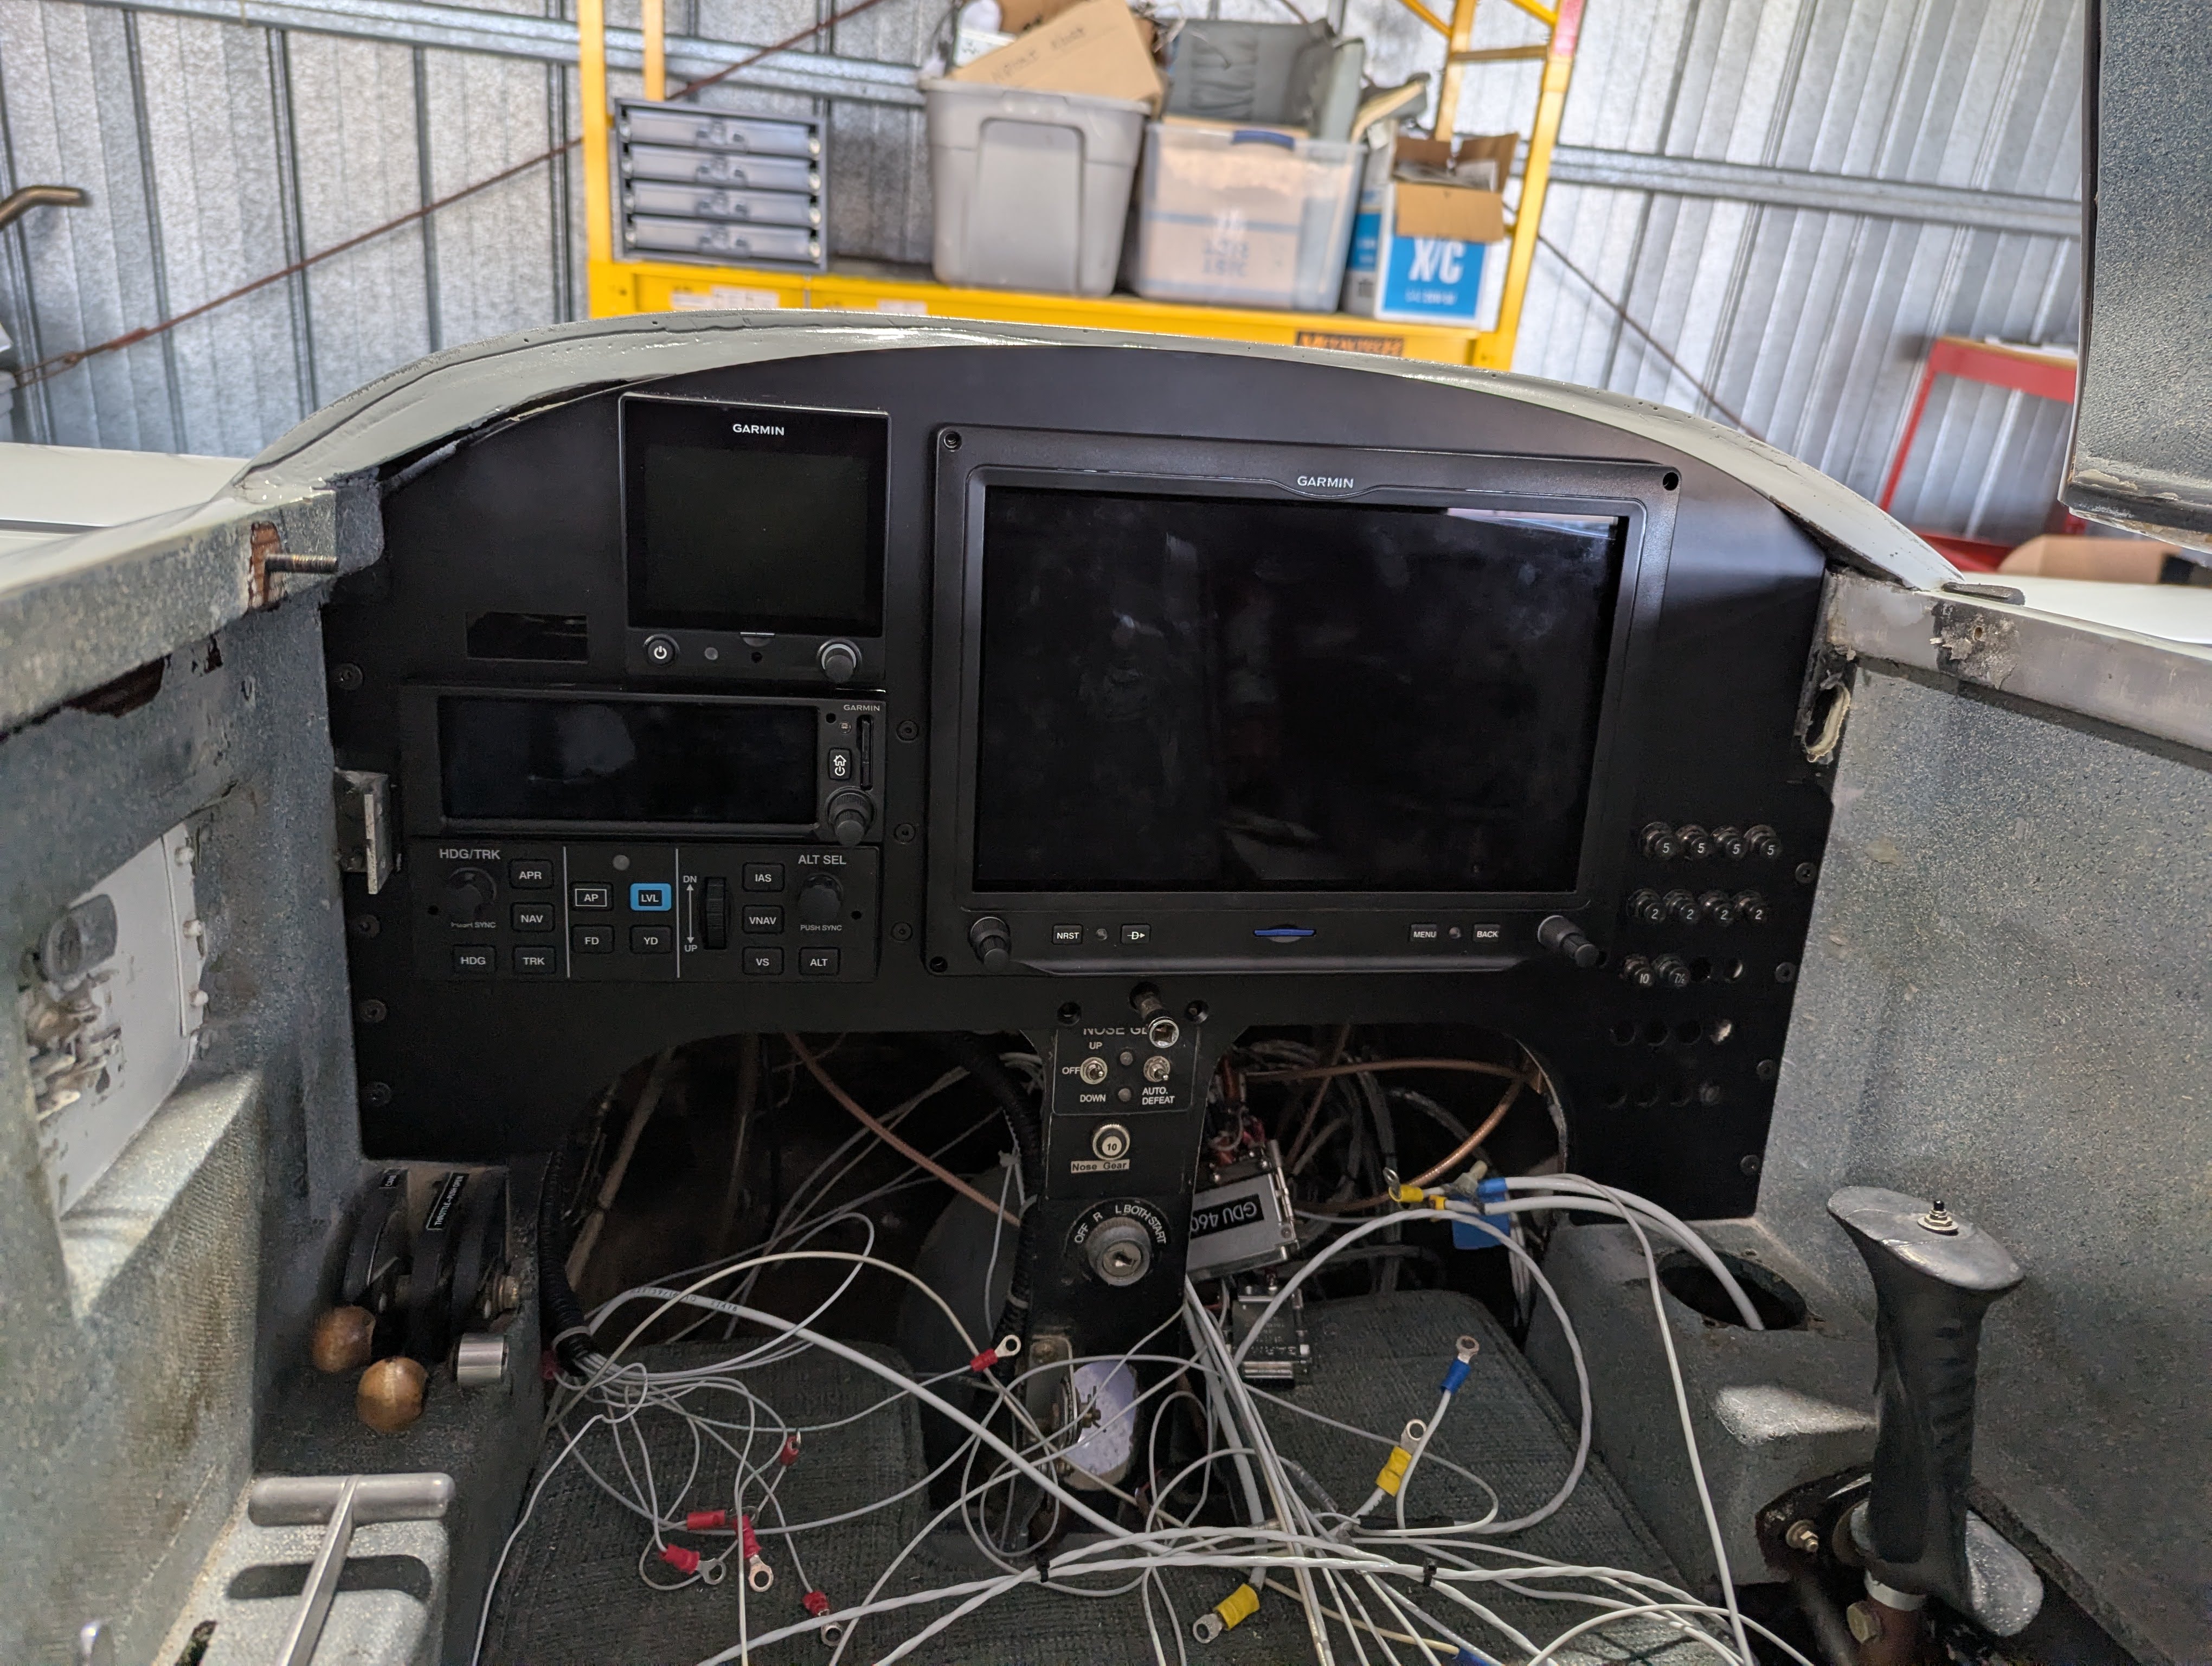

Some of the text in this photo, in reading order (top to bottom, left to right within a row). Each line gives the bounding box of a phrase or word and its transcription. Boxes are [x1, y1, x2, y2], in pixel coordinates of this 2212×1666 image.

[732, 424, 785, 436] GARMIN
[1297, 475, 1354, 489] GARMIN
[1662, 842, 1670, 854] 5
[1697, 843, 1705, 854] 5
[1732, 844, 1740, 855] 5
[1767, 844, 1775, 856] 5
[439, 849, 501, 860] HDG/TRK
[798, 855, 847, 865] ALT SEL
[519, 871, 542, 880] APR
[683, 875, 698, 883] DN
[755, 874, 772, 882] IAS
[584, 894, 599, 902] AP
[641, 894, 659, 903] LVL
[1651, 908, 1659, 919] 2
[1687, 909, 1694, 920] 2
[1720, 909, 1728, 920] 2
[1755, 909, 1763, 920] 2
[520, 914, 543, 923] NAV
[749, 917, 777, 925] VNAV
[1057, 932, 1080, 940] NRST
[585, 937, 600, 945] FD
[644, 937, 659, 945] YD
[684, 944, 698, 952] UP
[461, 957, 486, 965] HDG
[523, 957, 545, 965] TRK
[756, 958, 770, 966] VS
[809, 958, 828, 967] ALT
[1639, 973, 1650, 984] 10
[1062, 1067, 1081, 1075] OFF
[1142, 1087, 1168, 1095] AUTO.
[1080, 1094, 1107, 1103] DOWN
[1142, 1095, 1175, 1105] DEFEAT
[1107, 1143, 1117, 1151] 10
[1072, 1161, 1127, 1171] Nose Gear
[1115, 1204, 1122, 1213] L
[1123, 1204, 1152, 1220] BOTH
[1092, 1212, 1103, 1222] R
[1191, 1201, 1257, 1232] GDU 460
[1074, 1222, 1089, 1244] OFF
[1148, 1216, 1167, 1244] START
